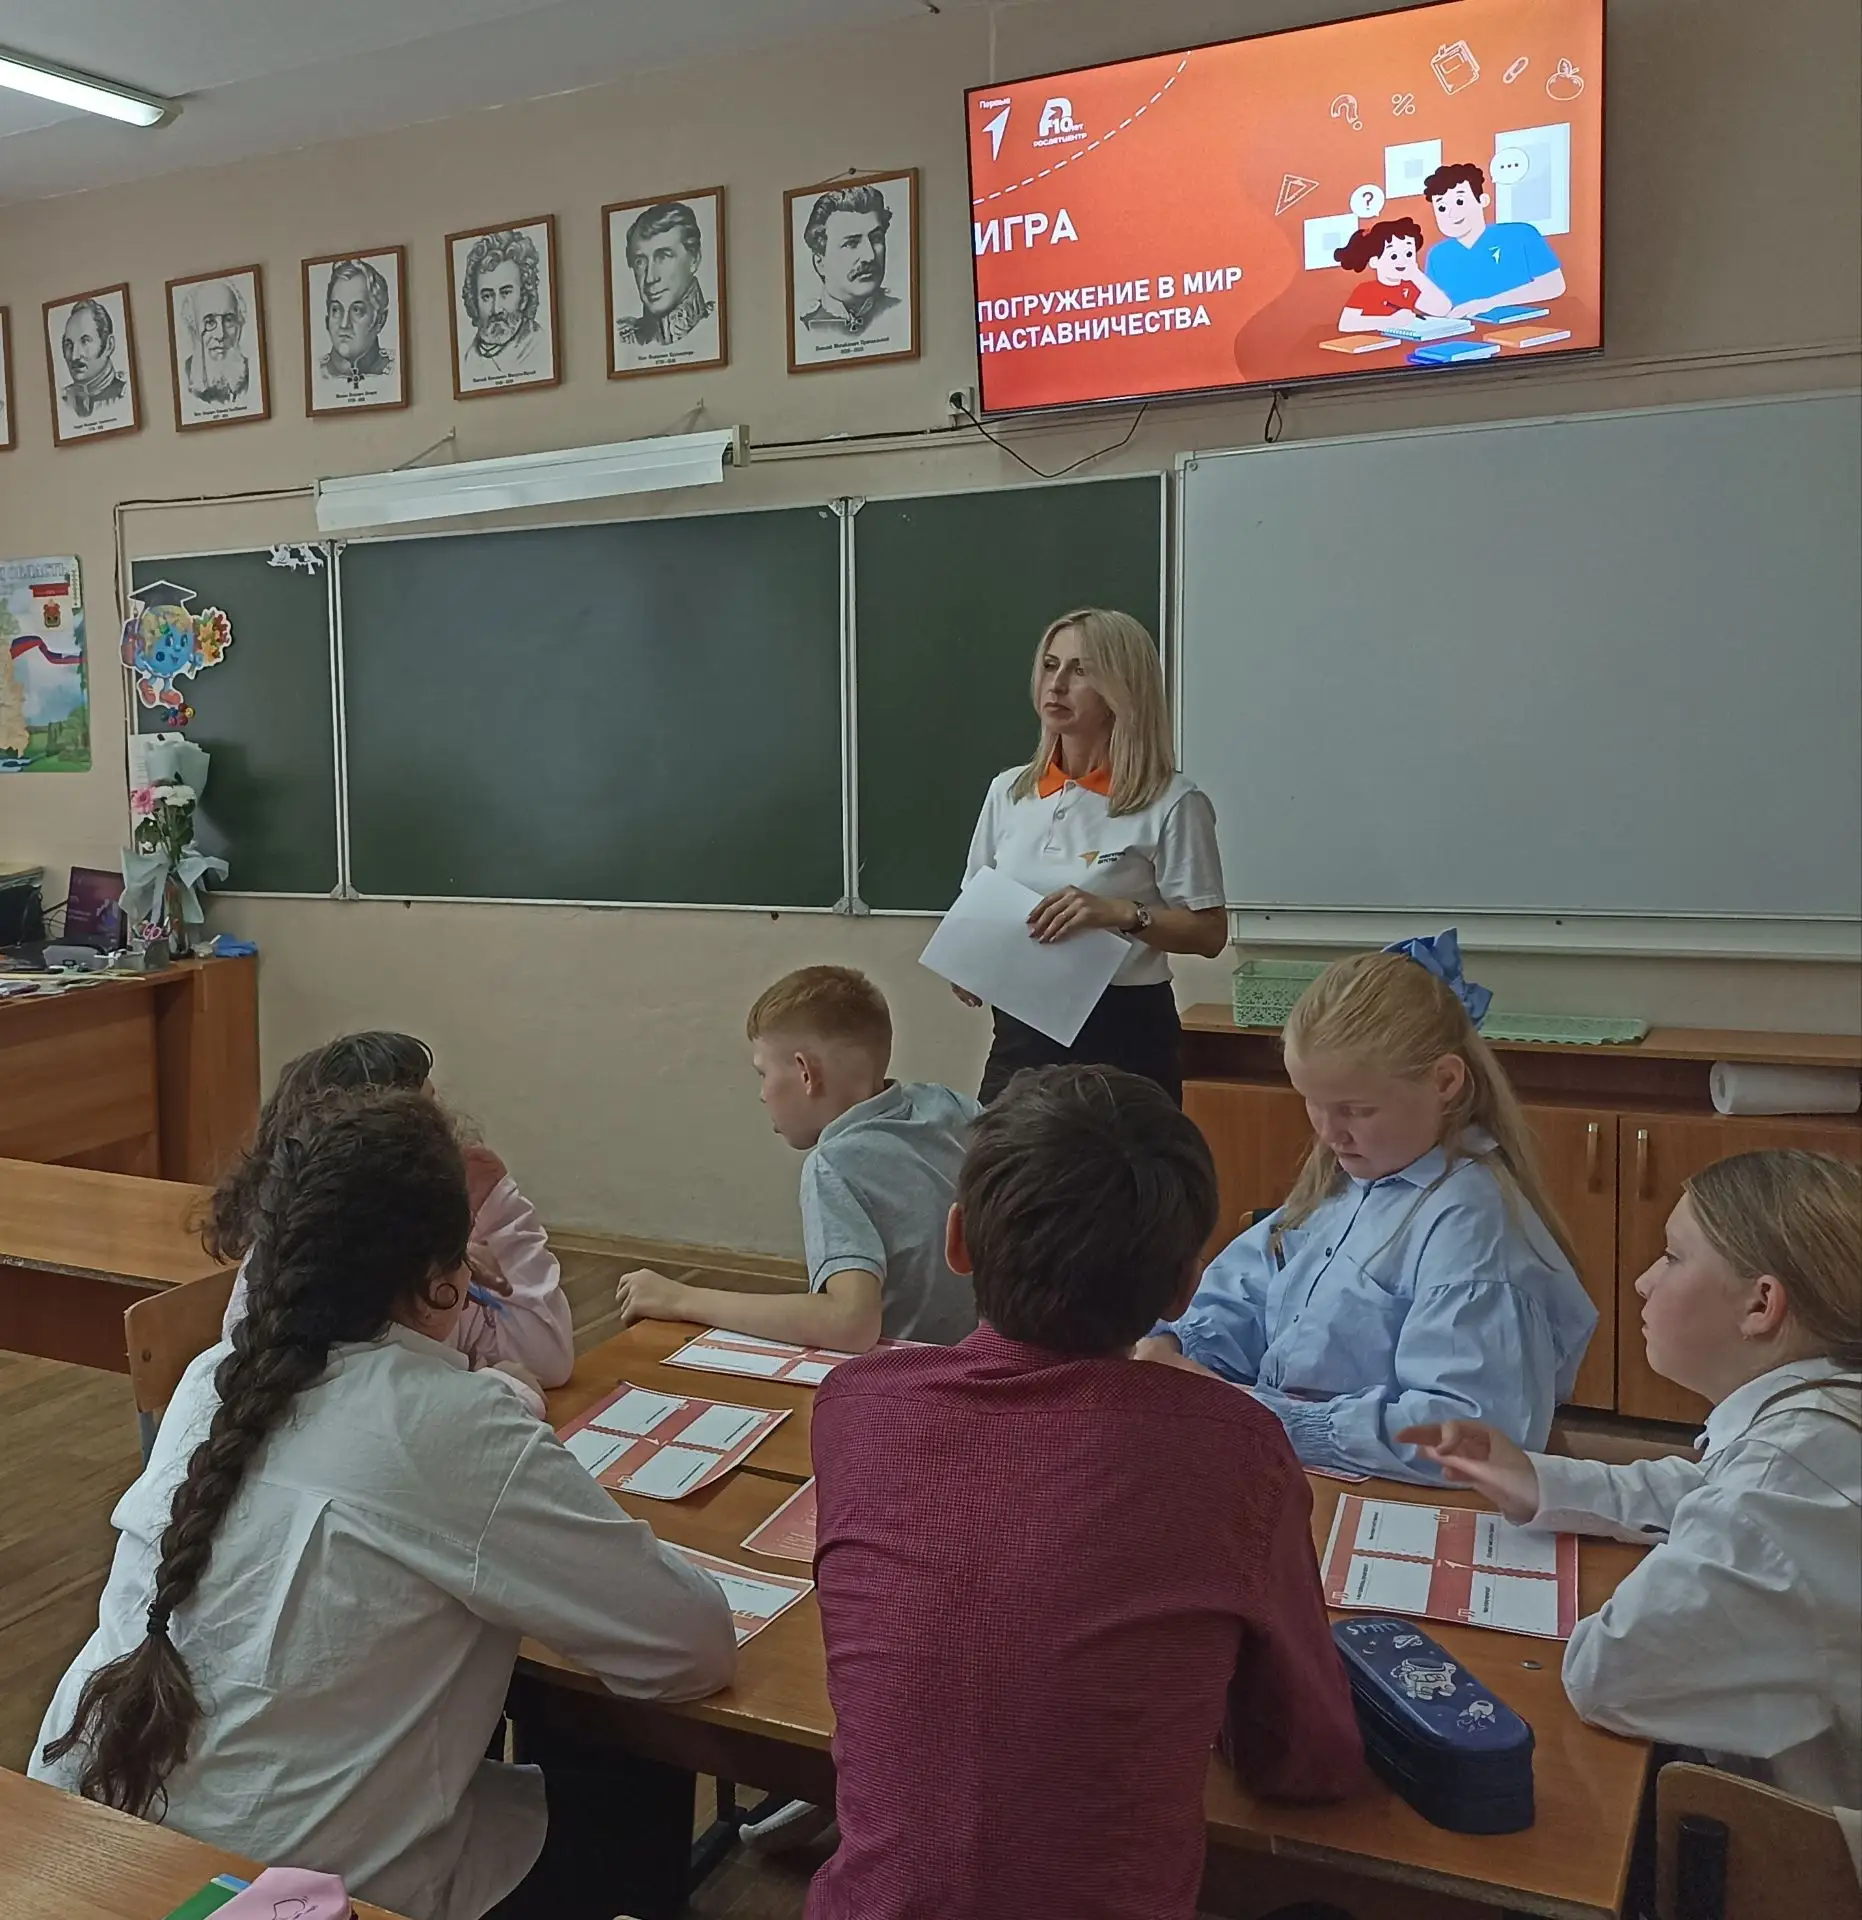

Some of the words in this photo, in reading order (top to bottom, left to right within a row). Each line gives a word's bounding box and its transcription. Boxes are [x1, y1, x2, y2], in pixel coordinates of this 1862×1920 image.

[979, 97, 1011, 109] Первые
[973, 208, 1079, 255] ИГРА
[978, 279, 1150, 322] ПОГРУЖЕНИЕ
[1158, 276, 1175, 299] В
[1183, 267, 1242, 296] МИР
[979, 304, 1211, 353] НАСТАВНИЧЕСТВА
